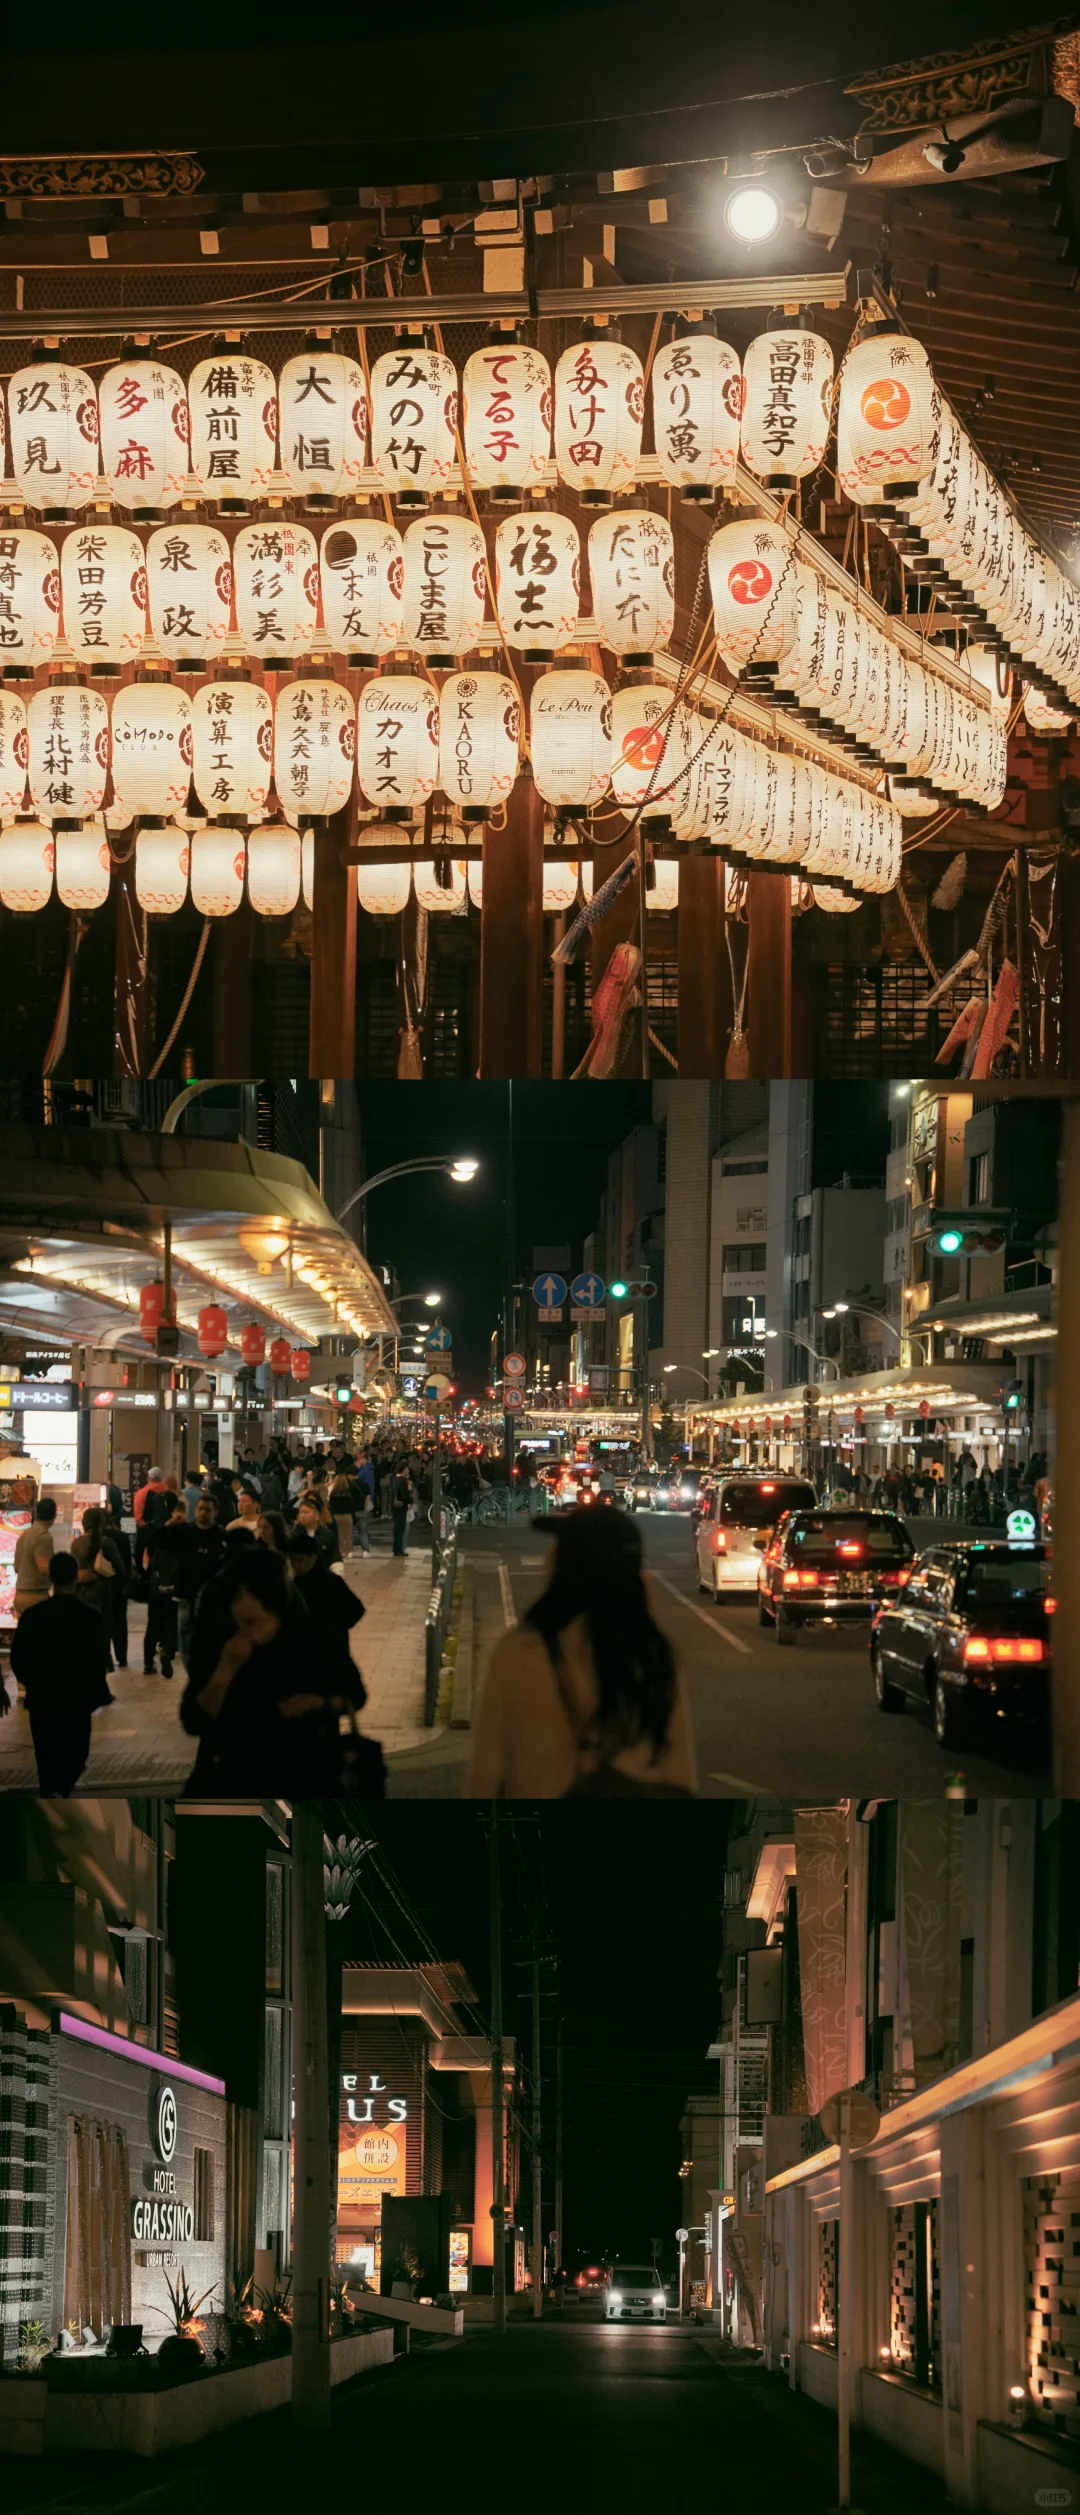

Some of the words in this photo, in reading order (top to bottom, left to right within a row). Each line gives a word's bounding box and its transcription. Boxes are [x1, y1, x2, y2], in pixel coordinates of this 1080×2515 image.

[240, 362, 255, 397] 富永町
[427, 355, 442, 396] 富永町
[521, 351, 534, 393] スナック
[762, 339, 801, 456] 高田真知子
[800, 338, 816, 385] 祇園甲部
[16, 381, 61, 475] 玖見
[114, 377, 155, 480] 多麻
[201, 366, 241, 480] 備前屋
[294, 366, 336, 471] 大恒
[385, 355, 427, 474] みの竹
[483, 355, 519, 462] てる子
[76, 535, 109, 647] 柴田芳豆
[159, 535, 202, 637] 泉政
[248, 532, 286, 642] 満彩美
[281, 528, 295, 574] 祇園東
[414, 525, 451, 641] こじま屋
[832, 610, 847, 696] Wands
[364, 688, 419, 713] Chaos
[538, 698, 556, 712] Le
[207, 692, 235, 802] 演算工房
[375, 717, 404, 794] カオス
[455, 702, 475, 795] KAORU
[13, 1391, 69, 1404] ドトールコーヒー
[342, 2075, 386, 2091] EL
[347, 2099, 407, 2122] US
[153, 2170, 177, 2194] HOTEL
[364, 2137, 389, 2150] 館内
[134, 2201, 193, 2241] GRASSINO
